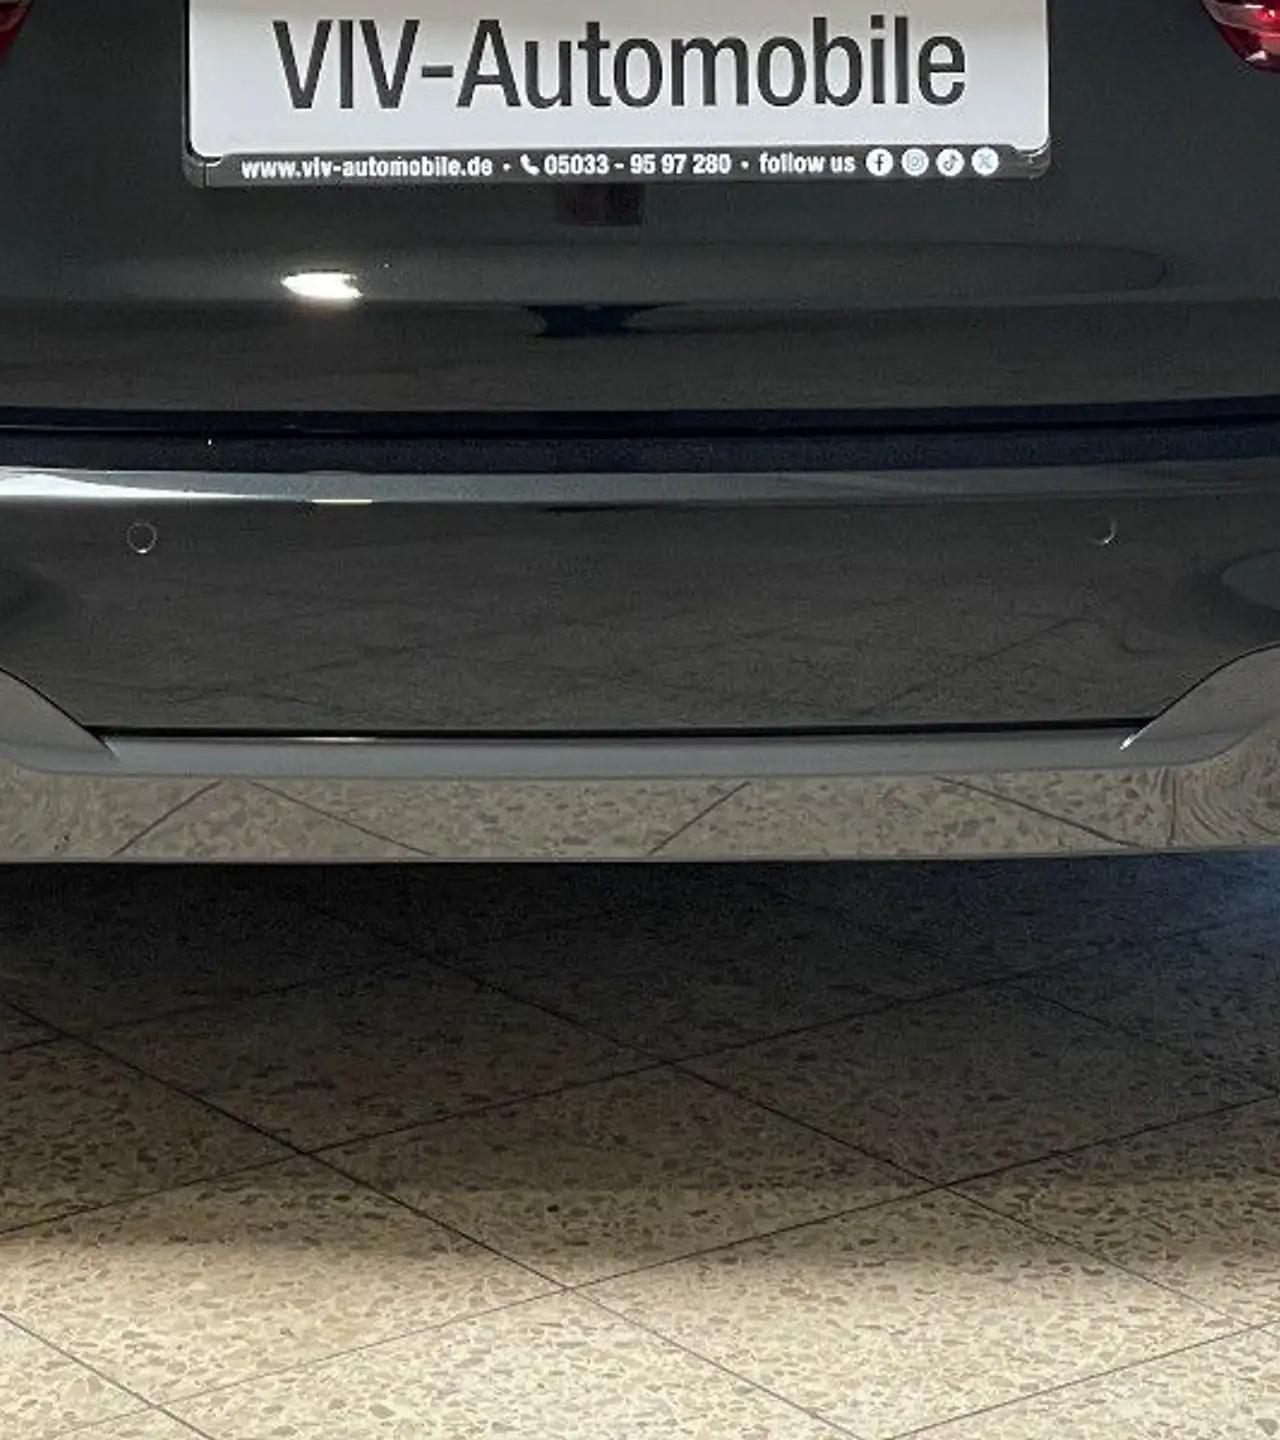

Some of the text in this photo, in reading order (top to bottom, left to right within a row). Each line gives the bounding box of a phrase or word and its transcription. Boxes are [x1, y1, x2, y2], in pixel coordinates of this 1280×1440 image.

[272, 13, 967, 110] VIV-Automobile
[241, 155, 494, 179] www.viv-automobile.de
[544, 153, 609, 175] 05033
[630, 153, 656, 175] 95
[661, 153, 687, 175] 97
[692, 153, 732, 174] 280
[759, 151, 825, 174] follow
[830, 155, 856, 174] us
